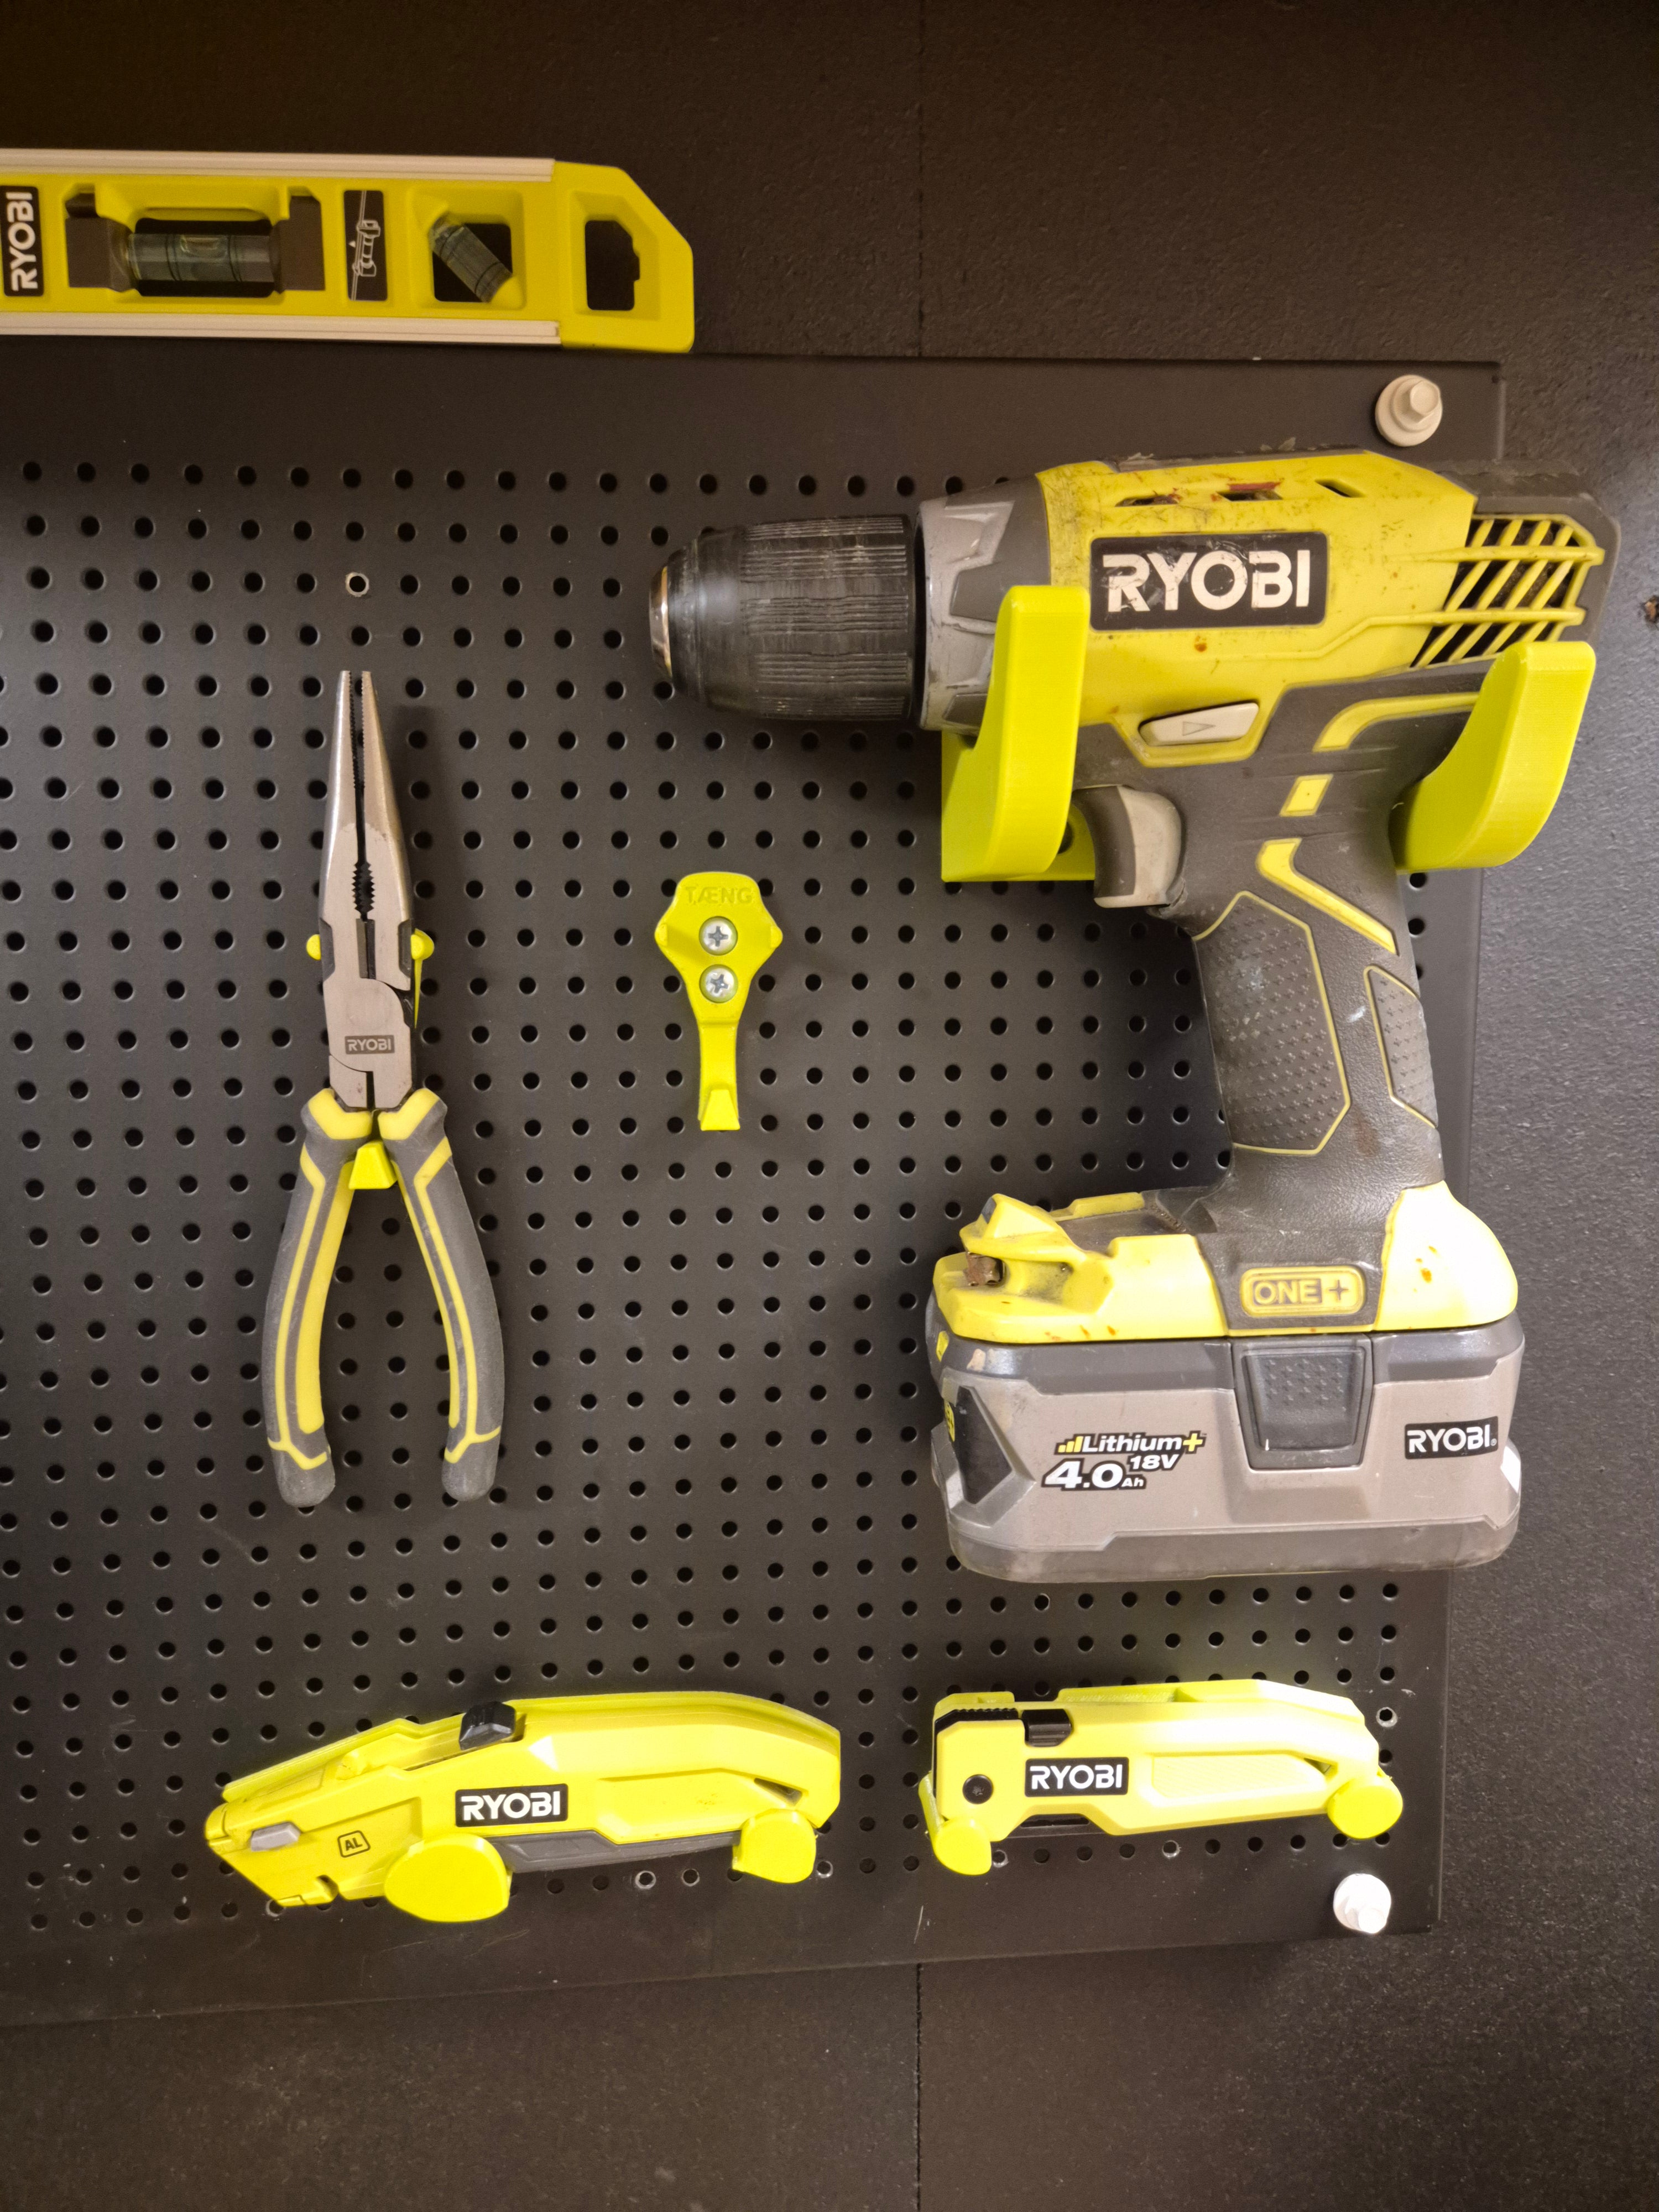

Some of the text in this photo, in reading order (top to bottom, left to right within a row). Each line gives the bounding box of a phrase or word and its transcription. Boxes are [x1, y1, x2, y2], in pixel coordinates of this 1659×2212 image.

[6, 192, 38, 291] RYOBI
[1103, 550, 1311, 612] RYOBI
[347, 1039, 392, 1051] RYOBI
[1130, 1454, 1180, 1470] 18V
[1030, 1764, 1123, 1790] RYOBI
[461, 1791, 561, 1821] RYOBI
[345, 1837, 363, 1851] AL
